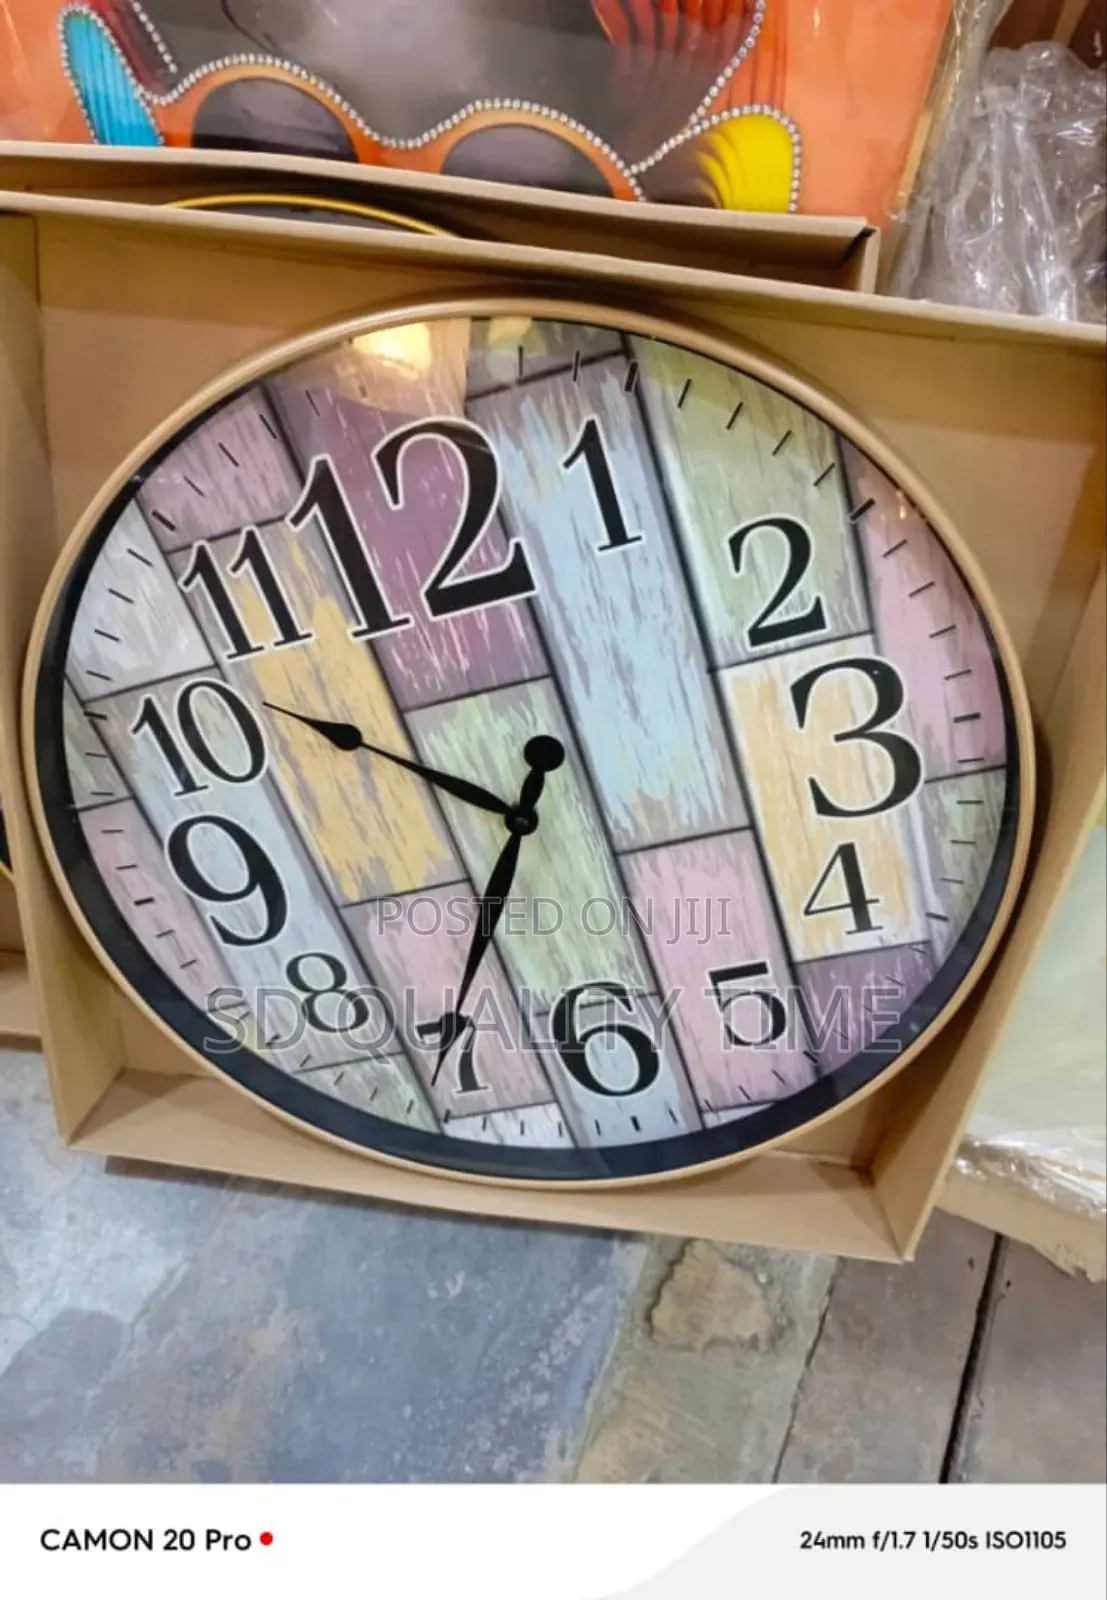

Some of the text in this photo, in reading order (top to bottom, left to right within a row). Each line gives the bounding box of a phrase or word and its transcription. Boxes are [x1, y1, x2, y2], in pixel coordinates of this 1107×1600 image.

[287, 416, 537, 638] 12
[562, 418, 642, 552] 1
[180, 526, 312, 661] 11
[728, 517, 827, 648] 2
[131, 678, 267, 798] 10
[790, 657, 922, 818] 3
[166, 814, 288, 947] 9
[803, 842, 883, 936] 4
[285, 952, 369, 1034] 8
[415, 1012, 489, 1095] 7
[551, 981, 660, 1097] 6
[708, 961, 787, 1047] 5
